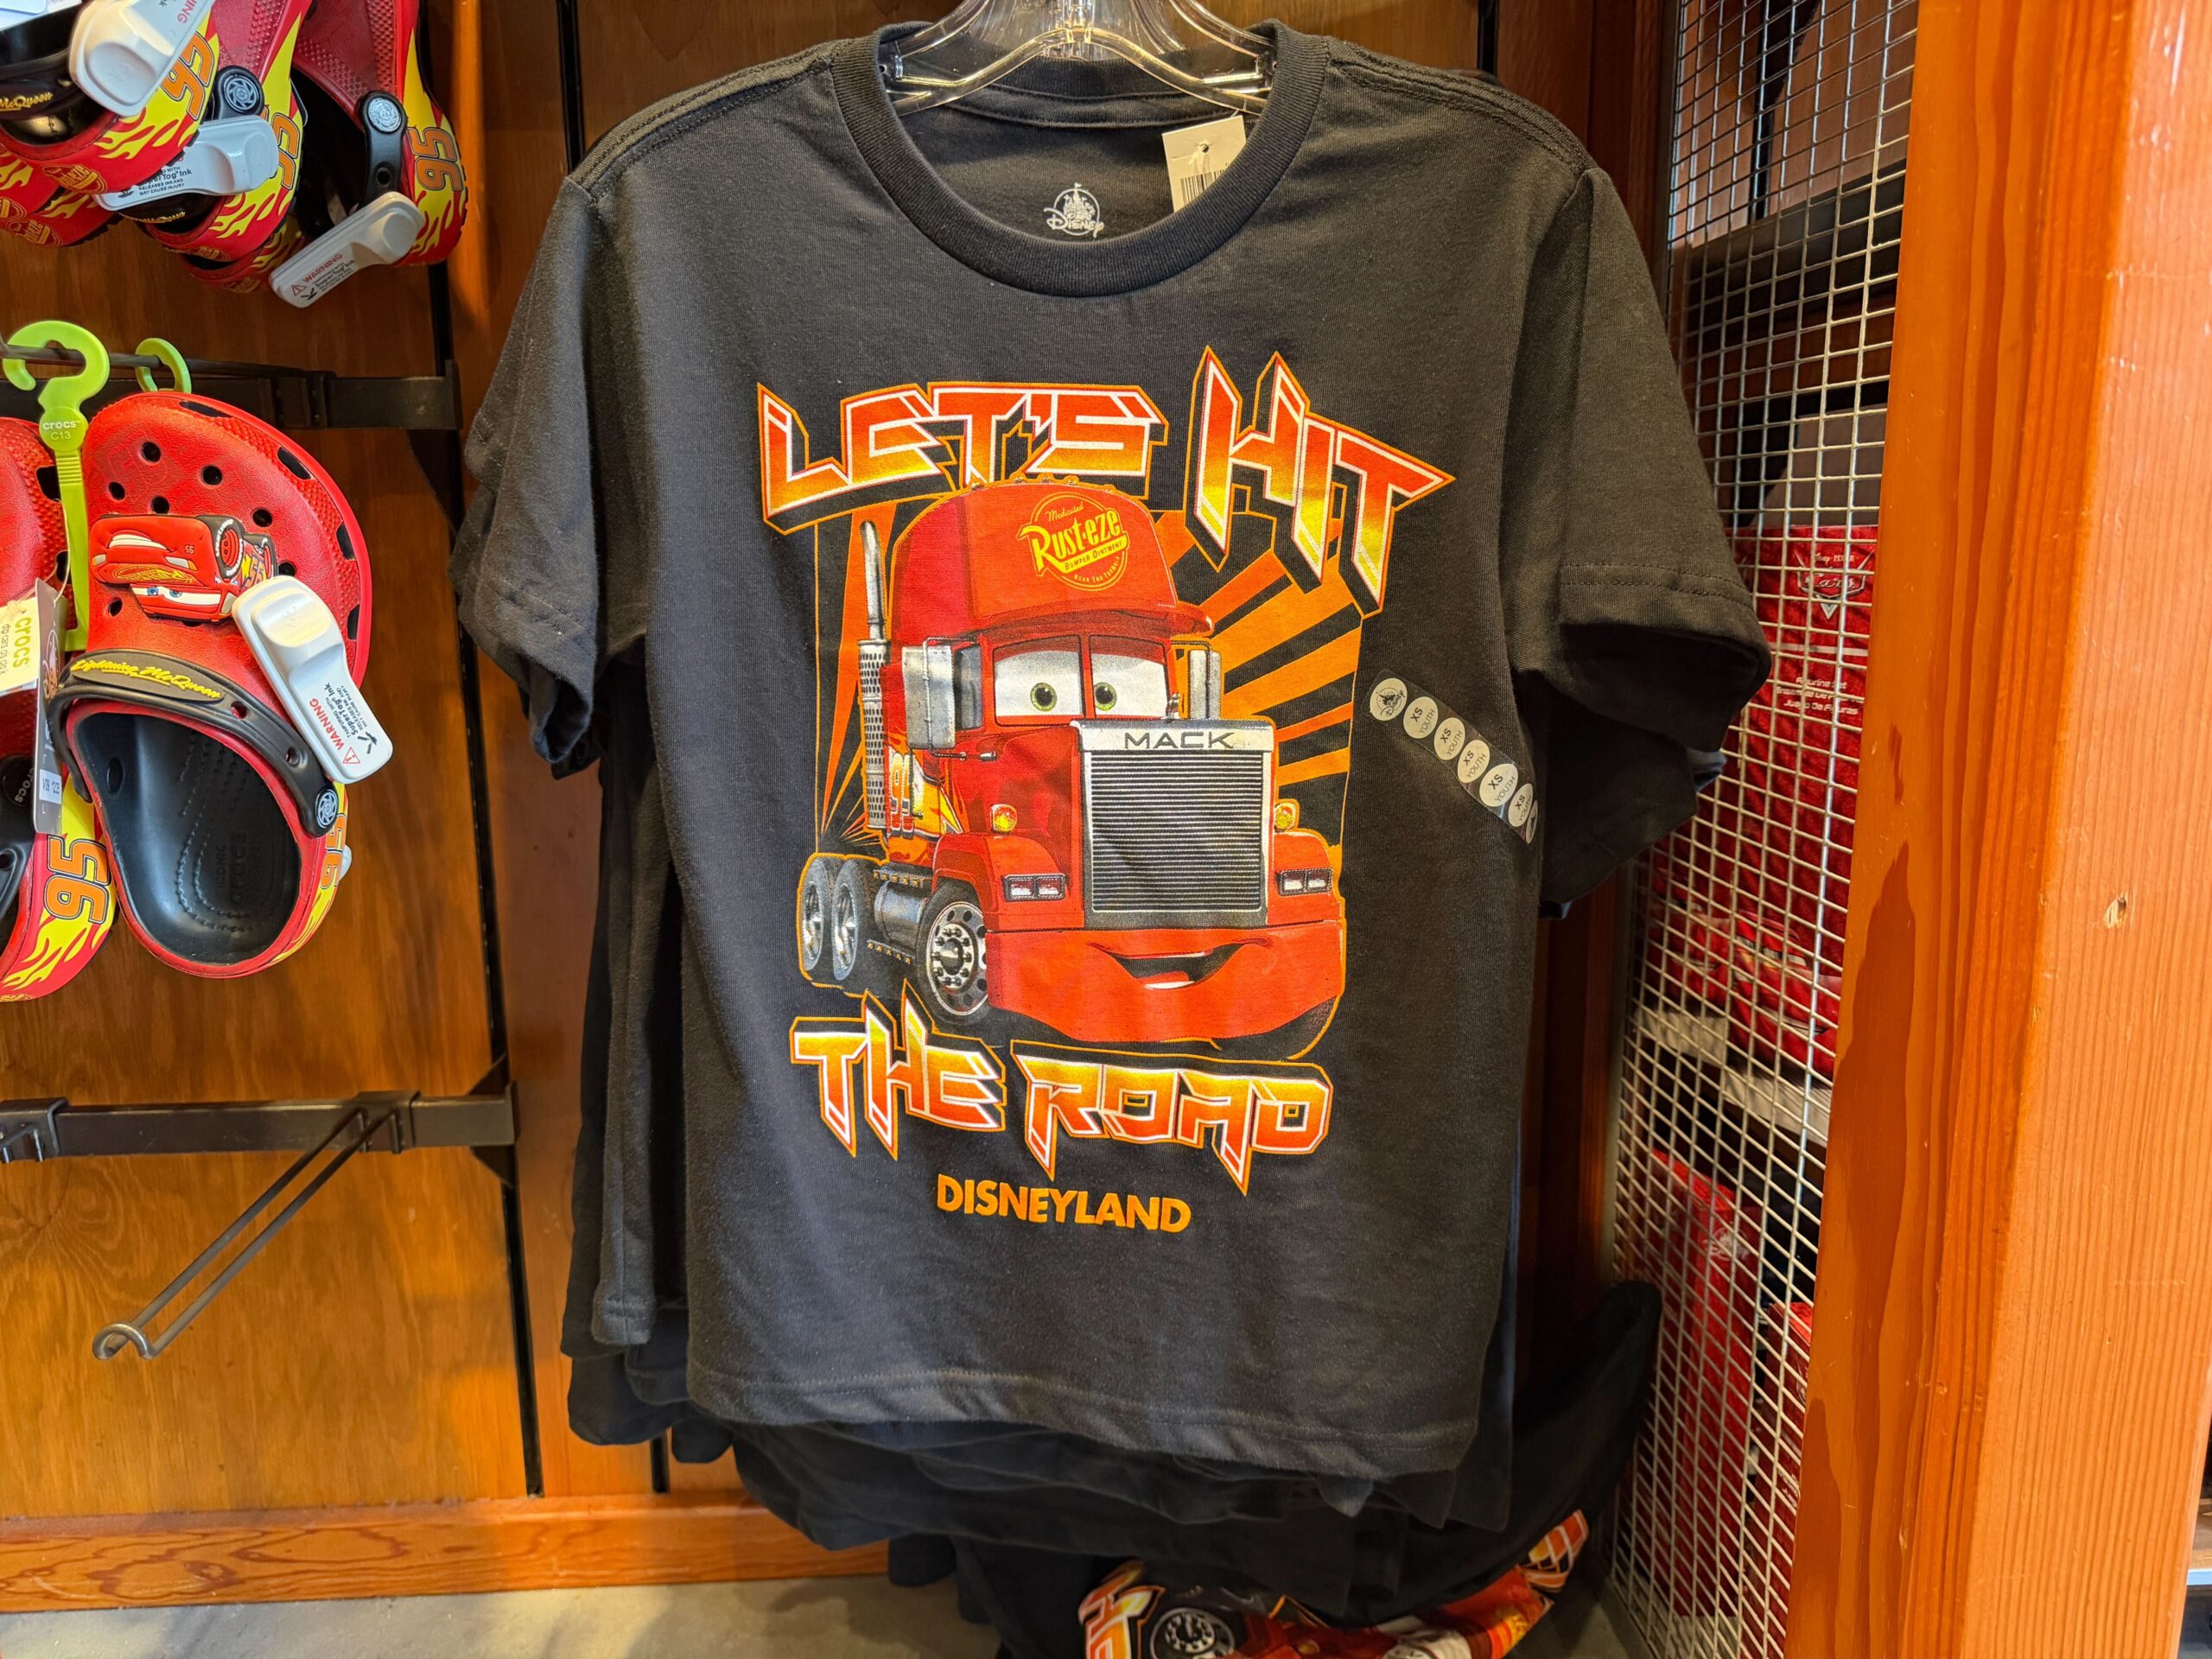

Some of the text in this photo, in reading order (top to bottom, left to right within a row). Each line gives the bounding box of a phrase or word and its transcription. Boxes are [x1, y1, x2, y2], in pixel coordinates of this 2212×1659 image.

[179, 168, 193, 177] Ink
[405, 127, 464, 192] 95
[1043, 207, 1105, 238] Disney
[303, 252, 343, 283] WARNING
[42, 420, 77, 430] crocs
[50, 430, 71, 441] C13
[758, 347, 1455, 615] LET'S HIT
[12, 615, 31, 669] crocs
[70, 659, 221, 699] Lightning McQueen
[324, 683, 335, 697] Ink
[309, 697, 345, 750] WARNING
[1410, 707, 1423, 722] XS
[1419, 709, 1435, 734] YOUTH
[1124, 731, 1235, 749] MACK
[1440, 728, 1452, 743] XS
[1446, 730, 1463, 756] YOUTH
[1463, 750, 1474, 766] XS
[1466, 753, 1487, 779] YOUTH
[1488, 774, 1503, 790] XS
[1494, 776, 1516, 803] YOUTH
[1515, 794, 1526, 810] XS
[44, 834, 112, 925] 95
[790, 980, 1334, 1196] THE ROAD
[936, 1174, 1192, 1234] DISNEYLAND
